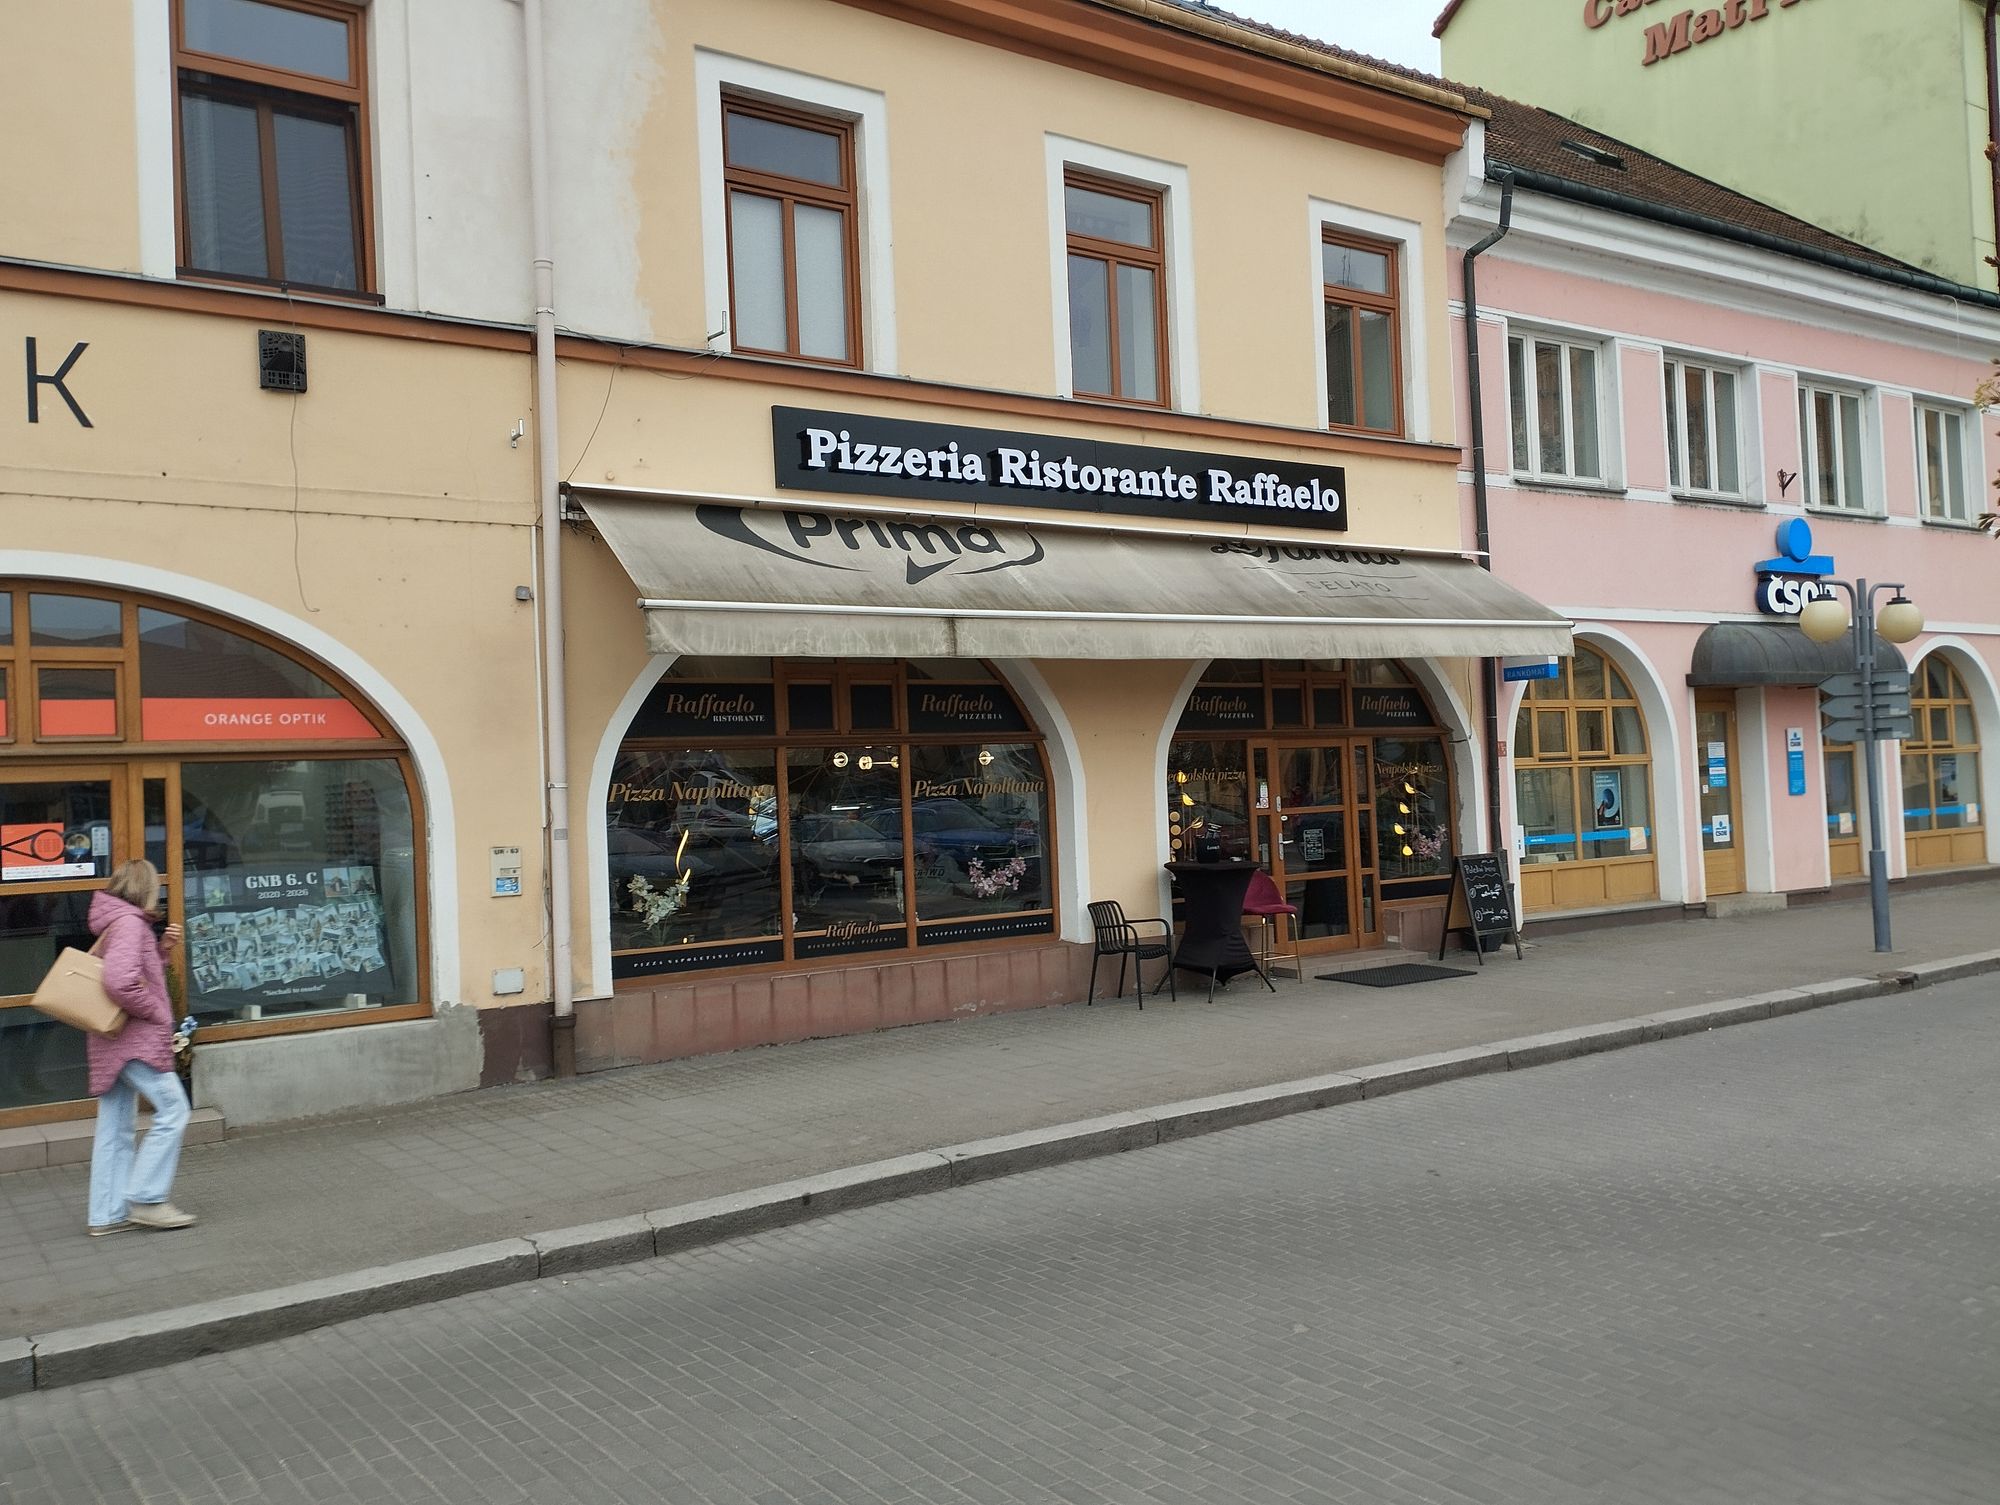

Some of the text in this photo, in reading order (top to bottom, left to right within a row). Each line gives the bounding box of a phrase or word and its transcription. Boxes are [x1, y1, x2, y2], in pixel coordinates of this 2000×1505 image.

[26, 336, 94, 428] K
[806, 428, 1340, 512] Pizzeria Ristorante Raffaelo
[782, 511, 1006, 555] Prima
[1507, 667, 1546, 678] BANKOMAT
[666, 693, 755, 719] Raffaelo
[921, 694, 993, 717] Raffaelo
[1188, 696, 1247, 716] Raffaelo
[1361, 695, 1410, 715] Raffaelo
[204, 713, 327, 726] ORANGE OPTIK
[713, 714, 766, 723] RISTORANTE
[608, 783, 665, 803] Pizza
[914, 776, 1045, 801] Pizza Napolitana
[245, 872, 318, 889] GNB 6. C
[826, 921, 880, 940] Raffaelo
